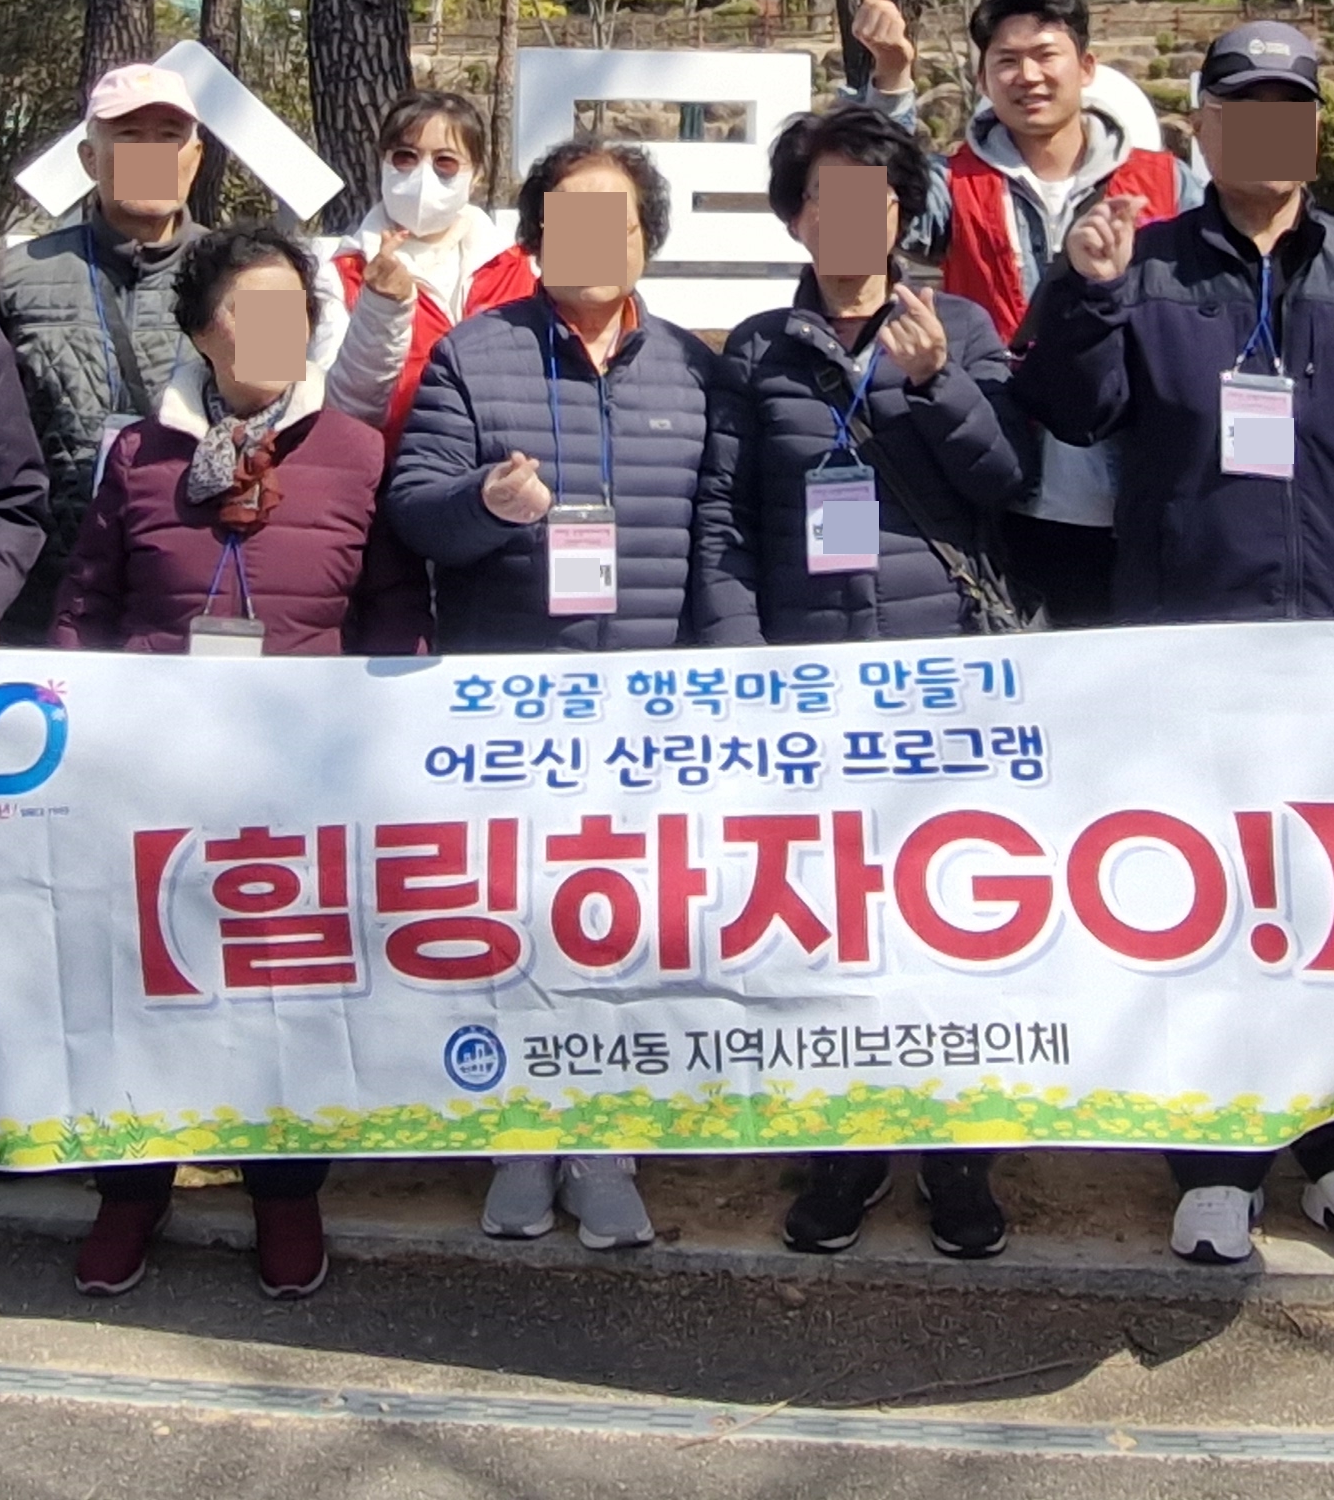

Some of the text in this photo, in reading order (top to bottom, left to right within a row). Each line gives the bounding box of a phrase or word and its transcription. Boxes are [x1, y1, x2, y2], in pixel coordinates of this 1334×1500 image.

[449, 657, 1016, 719] 호암골 행복마을 만들기
[425, 725, 1043, 788] 어르신 산림치유 프로그램
[523, 1021, 1070, 1077] 광안4동 지역사회보장협의체
